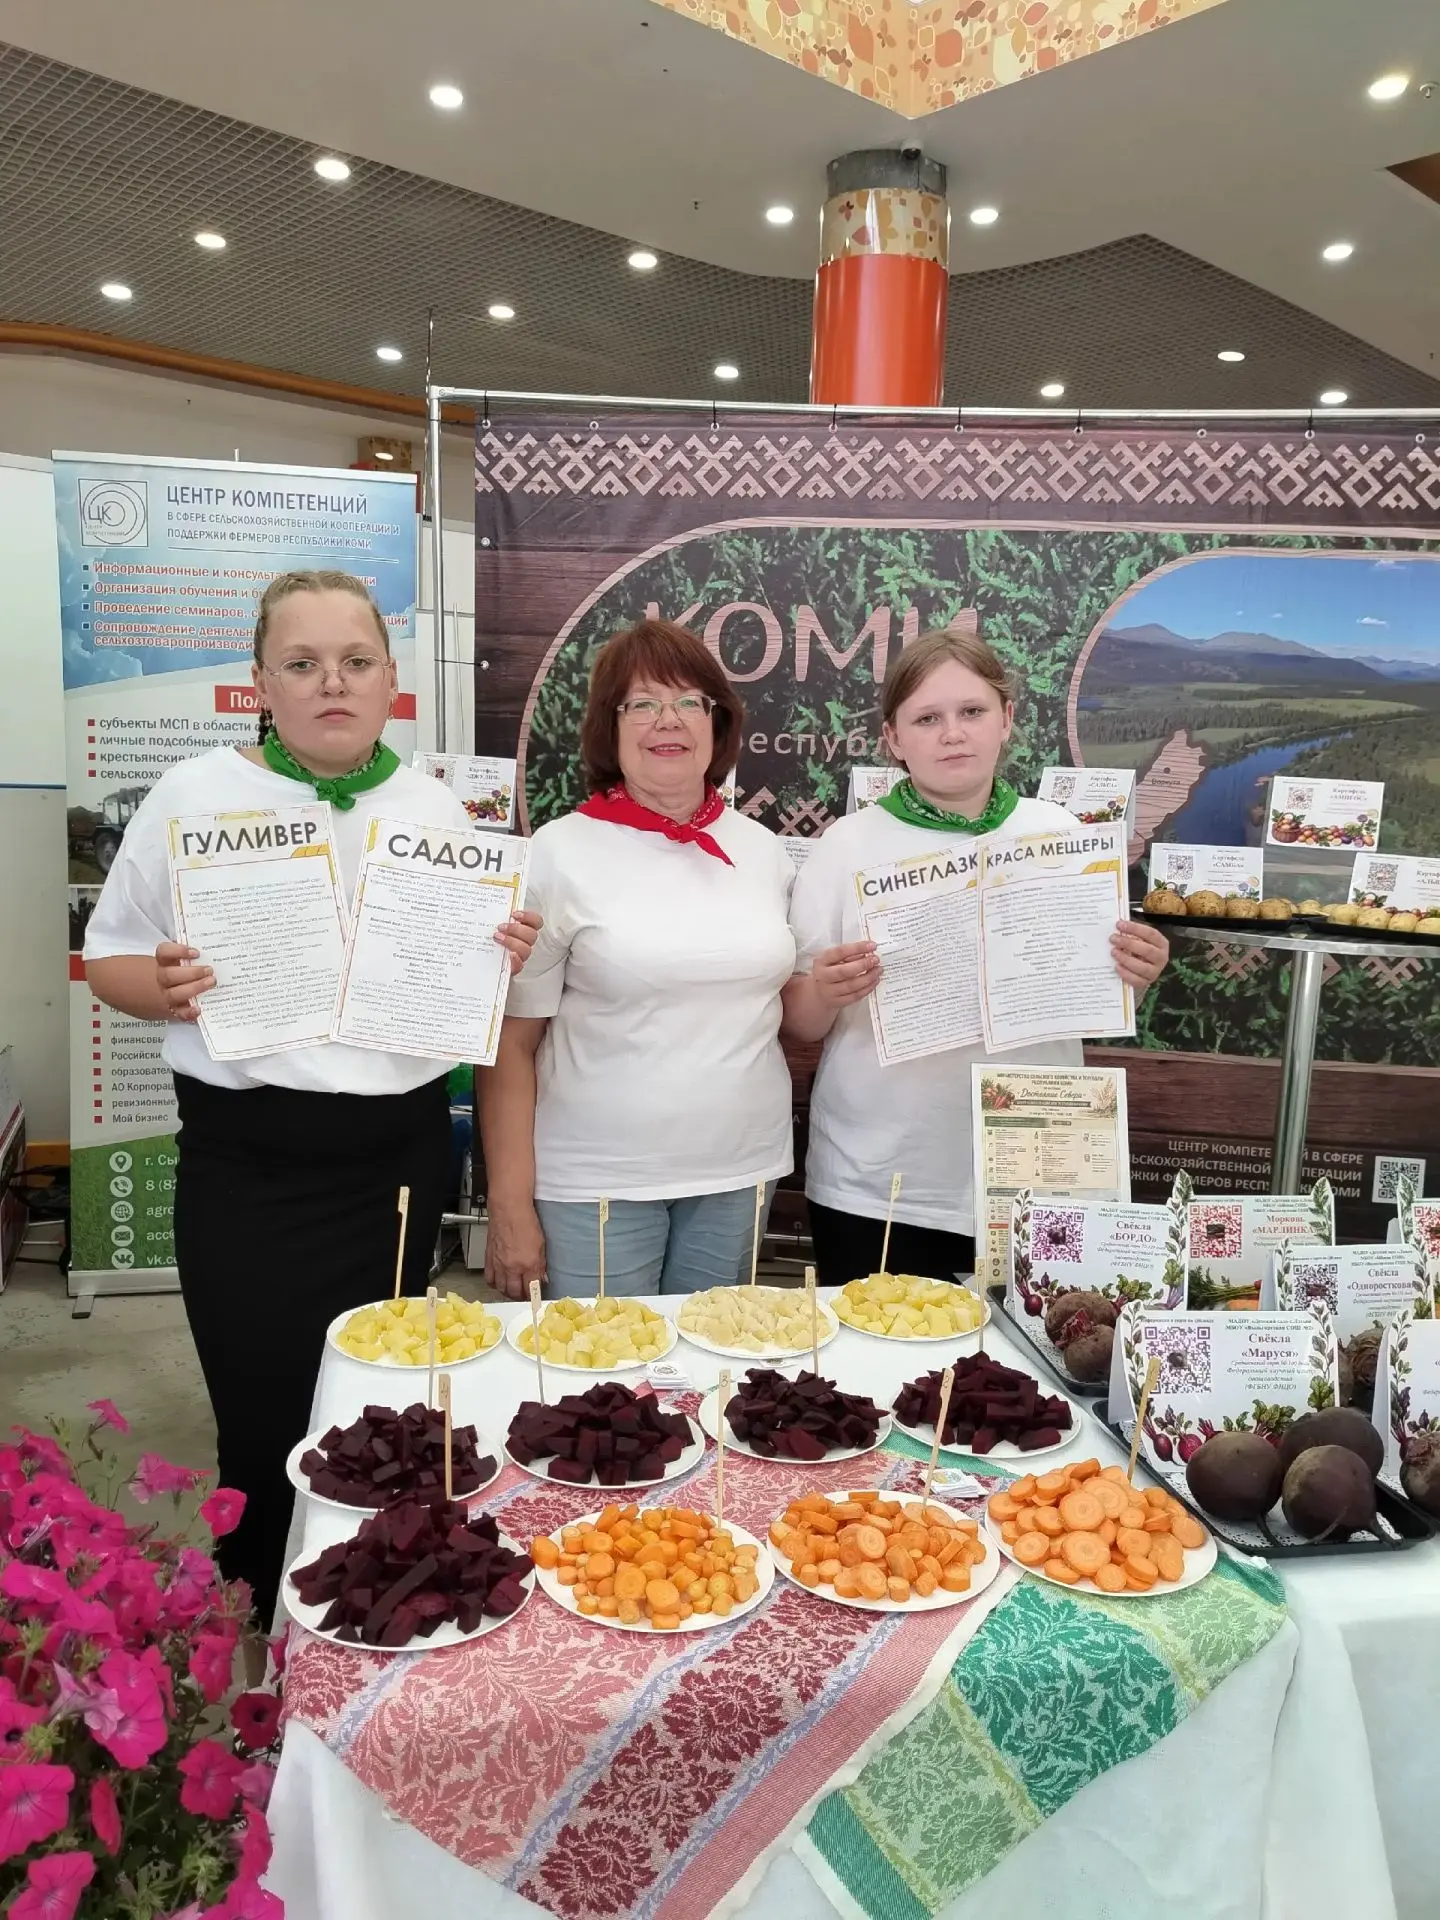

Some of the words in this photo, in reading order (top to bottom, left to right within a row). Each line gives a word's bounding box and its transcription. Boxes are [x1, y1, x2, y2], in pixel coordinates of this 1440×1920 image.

[167, 486, 226, 506] ЦЕНТР
[232, 489, 367, 515] КОМПЕТЕНЦИЙ
[88, 505, 111, 524] ЦК
[168, 511, 174, 520] В
[176, 512, 207, 523] СФЕРЕ
[209, 514, 328, 529] СЕЛЬСКОХОЗЯЙСТВЕННОЙ
[330, 521, 390, 535] КООПЕРАЦИИ
[168, 528, 226, 541] ПОДДЕРЖКИ
[229, 533, 281, 544] ФЕРМЕРОВ
[283, 535, 343, 547] РЕСПУБЛИКИ
[345, 539, 372, 549] КОМИ
[95, 563, 209, 577] Информационные
[212, 570, 220, 578] и
[95, 582, 176, 595] Организация
[180, 583, 238, 598] обучения
[241, 590, 248, 598] и
[95, 602, 170, 615] Проведение
[174, 604, 248, 619] семинаров,
[95, 621, 195, 634] Сопровождение
[100, 717, 156, 733] субъекты
[160, 718, 189, 730] МСП
[193, 722, 200, 730] в
[203, 719, 250, 731] области
[100, 736, 146, 745] личные
[150, 734, 219, 748] подсобные
[748, 726, 885, 762] еспуб
[100, 753, 186, 764] крестьянские
[101, 769, 163, 780] сельскохо
[182, 821, 317, 856] ГУЛЛИВЕР
[388, 834, 503, 873] САДОН
[986, 846, 1035, 869] КРАСА
[1040, 836, 1114, 857] МЕЩЕРЫ
[110, 1021, 167, 1031] лизинговые
[111, 1082, 124, 1091] АО
[112, 1099, 176, 1110] ревизионные
[112, 1113, 133, 1123] Мой
[135, 1113, 168, 1123] бизнес
[1168, 1140, 1209, 1153] ЦЕНТР
[1311, 1151, 1320, 1160] В
[1323, 1151, 1364, 1165] СФЕРЕ
[145, 1157, 154, 1166] г.
[1129, 1153, 1272, 1175] ЬСКОХОЗЯЙСТВЕННОЙ
[145, 1180, 155, 1191] 8
[1162, 1172, 1232, 1188] ФМЕРОВ
[1332, 1185, 1361, 1198] ОМИ
[1116, 1220, 1151, 1231] Свёкла
[1266, 1214, 1305, 1225] Морковь
[1109, 1232, 1157, 1243] «БОРДО»
[1368, 1268, 1399, 1278] Свёкла
[1248, 1333, 1291, 1343] Свёкла
[1241, 1348, 1299, 1360] «Маруся»
